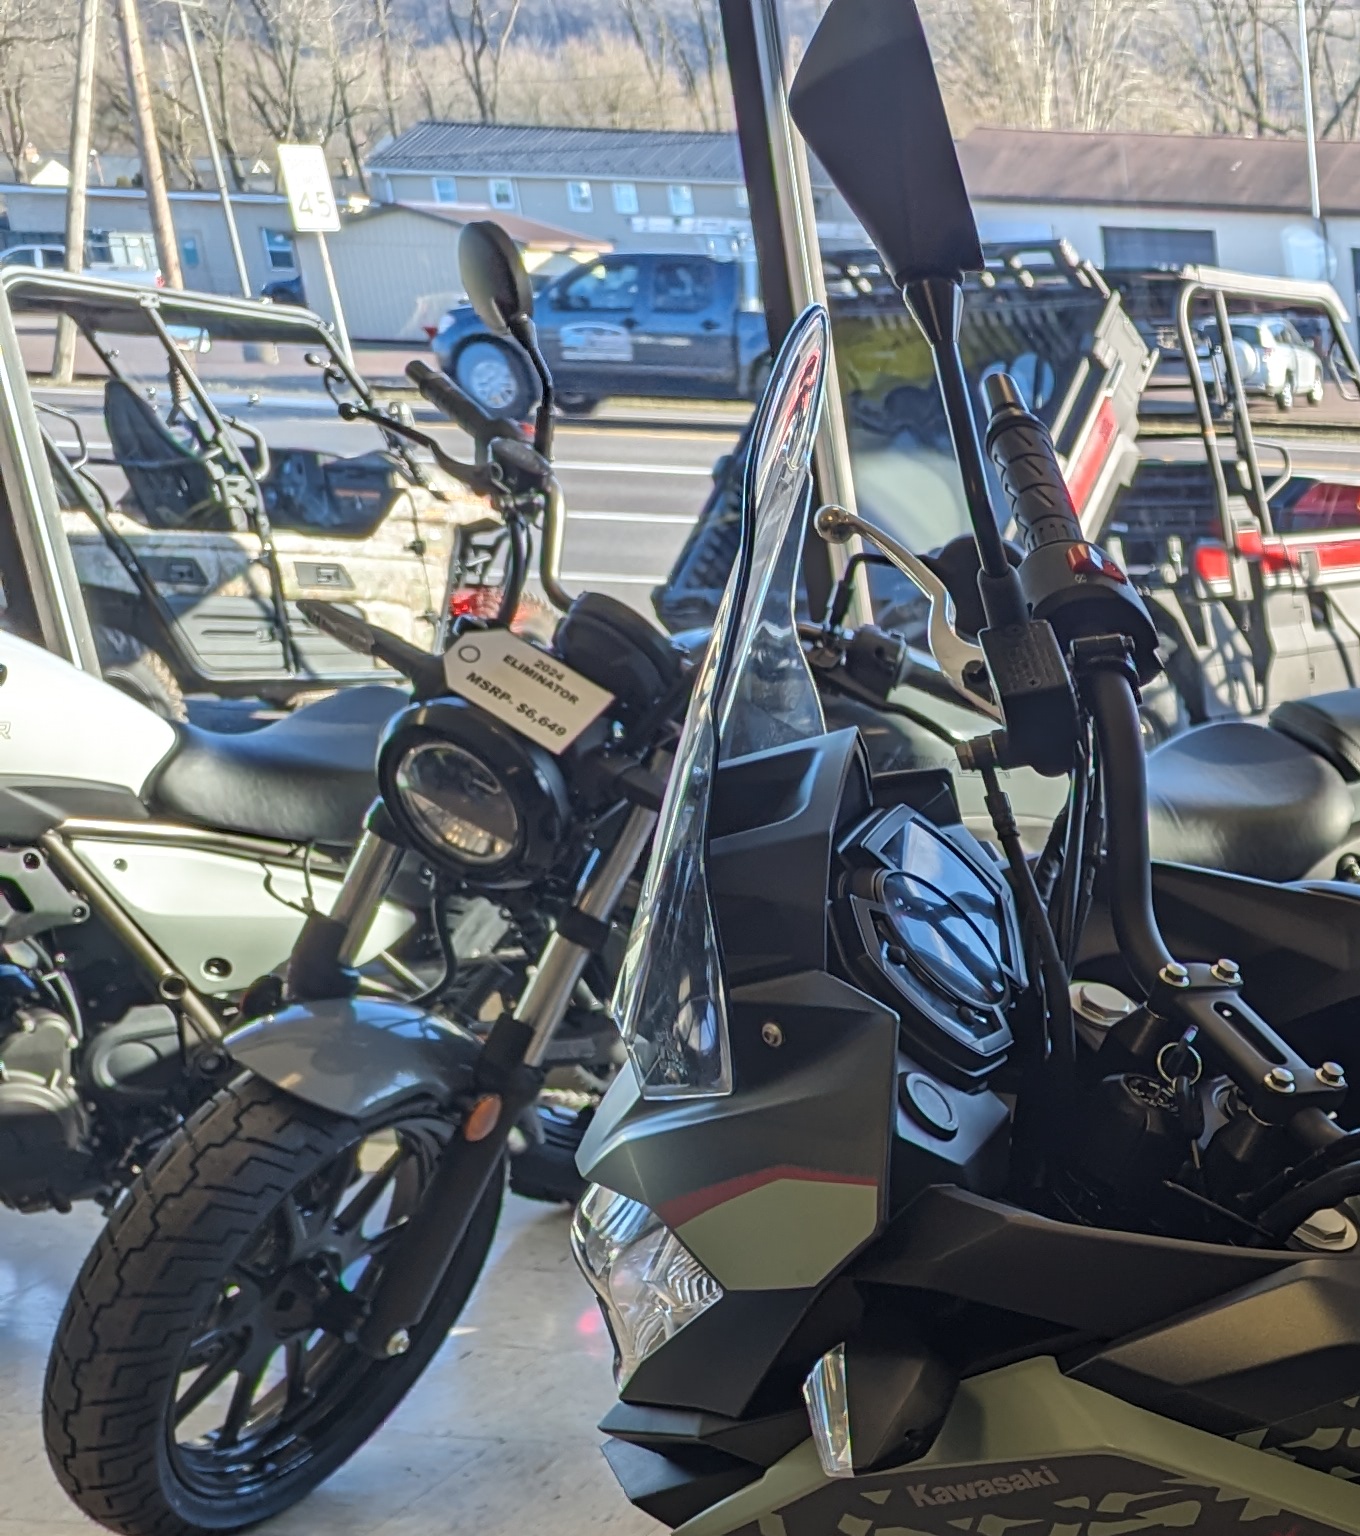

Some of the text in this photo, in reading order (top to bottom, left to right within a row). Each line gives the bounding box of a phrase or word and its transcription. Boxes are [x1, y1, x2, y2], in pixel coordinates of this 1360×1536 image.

[298, 191, 331, 218] 45
[502, 654, 580, 706] ELIMINATOR
[533, 659, 566, 682] 2024
[516, 702, 567, 737] $6,649
[906, 1464, 1060, 1512] Kawasaki
